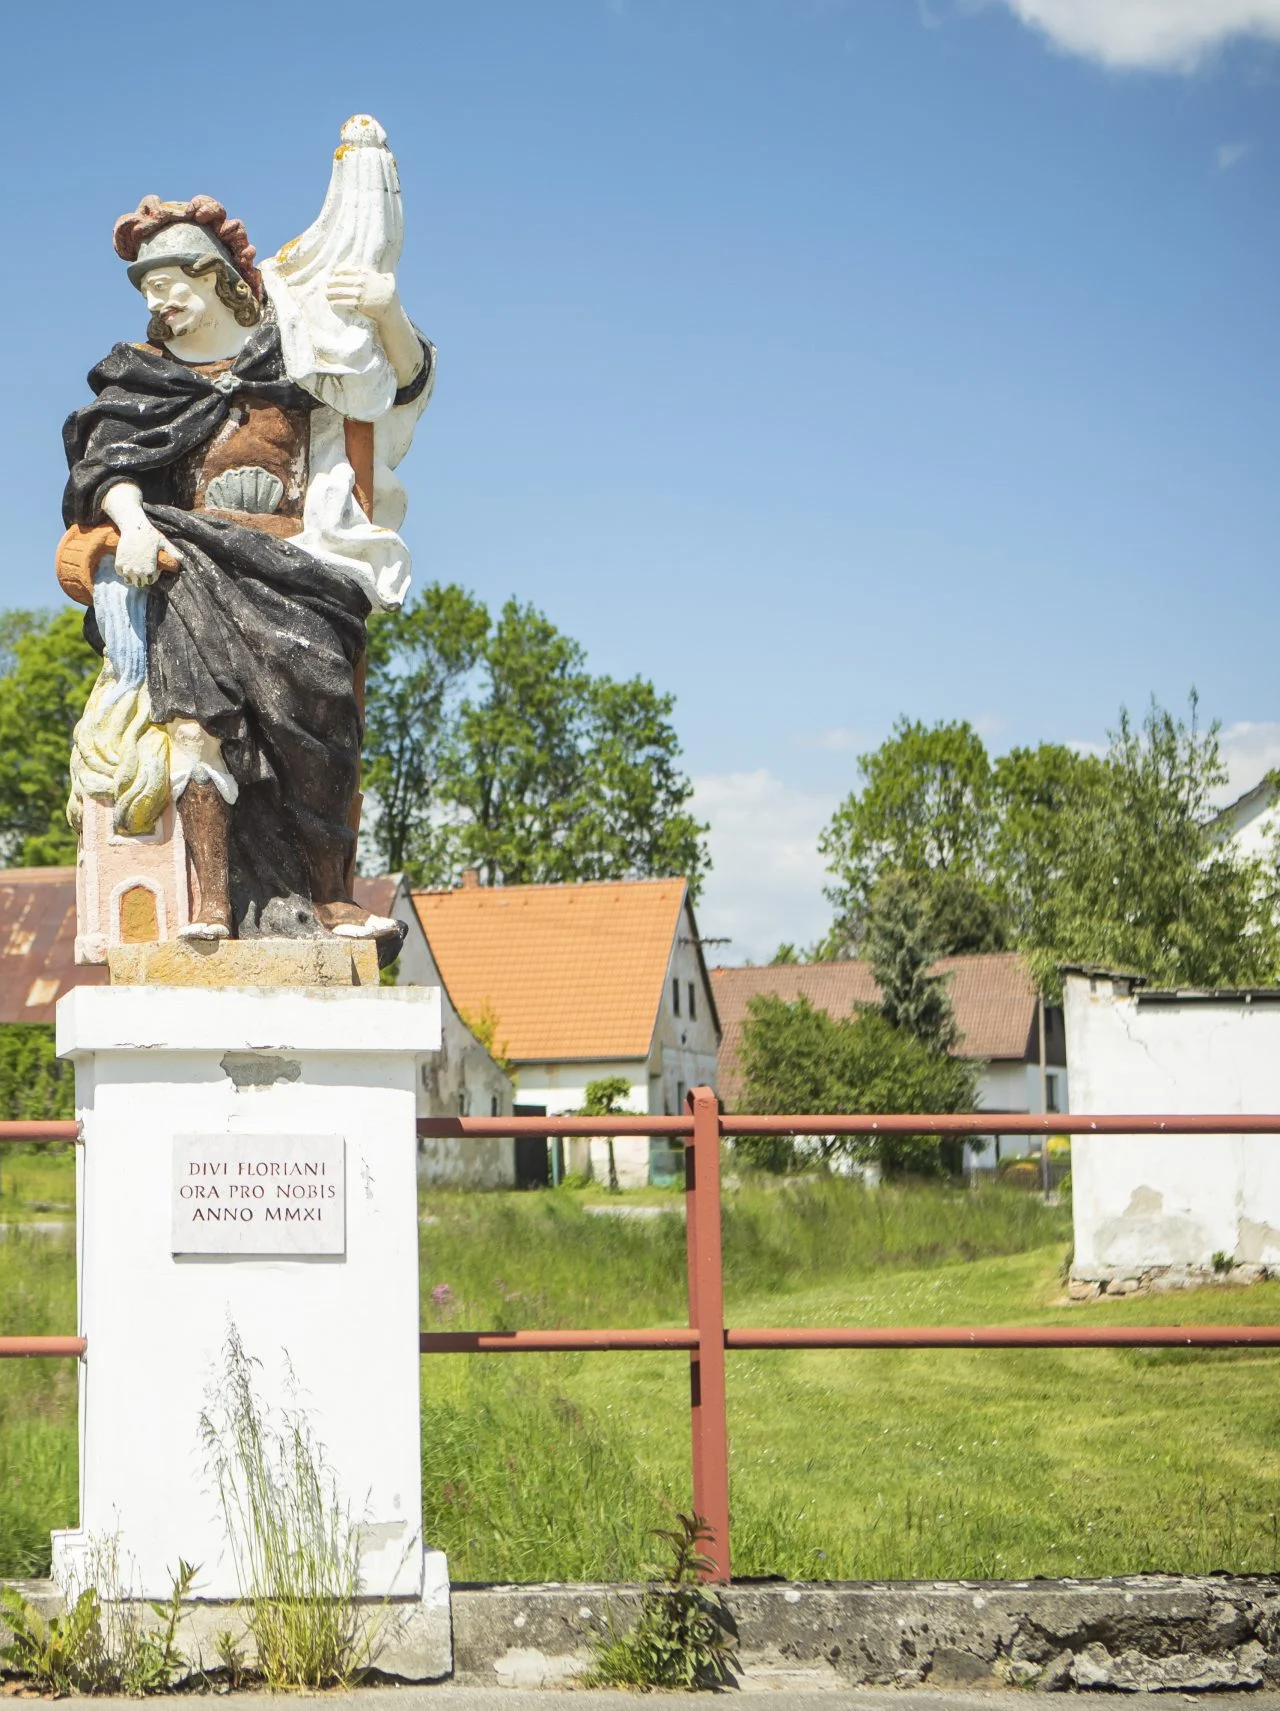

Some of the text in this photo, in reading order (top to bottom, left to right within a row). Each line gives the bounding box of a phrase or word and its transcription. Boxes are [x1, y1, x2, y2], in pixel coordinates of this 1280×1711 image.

[189, 1162, 326, 1176] DIVI FLORIANI
[179, 1184, 336, 1199] ORA PRO NOBIS
[192, 1207, 322, 1222] ANNO MMXI
